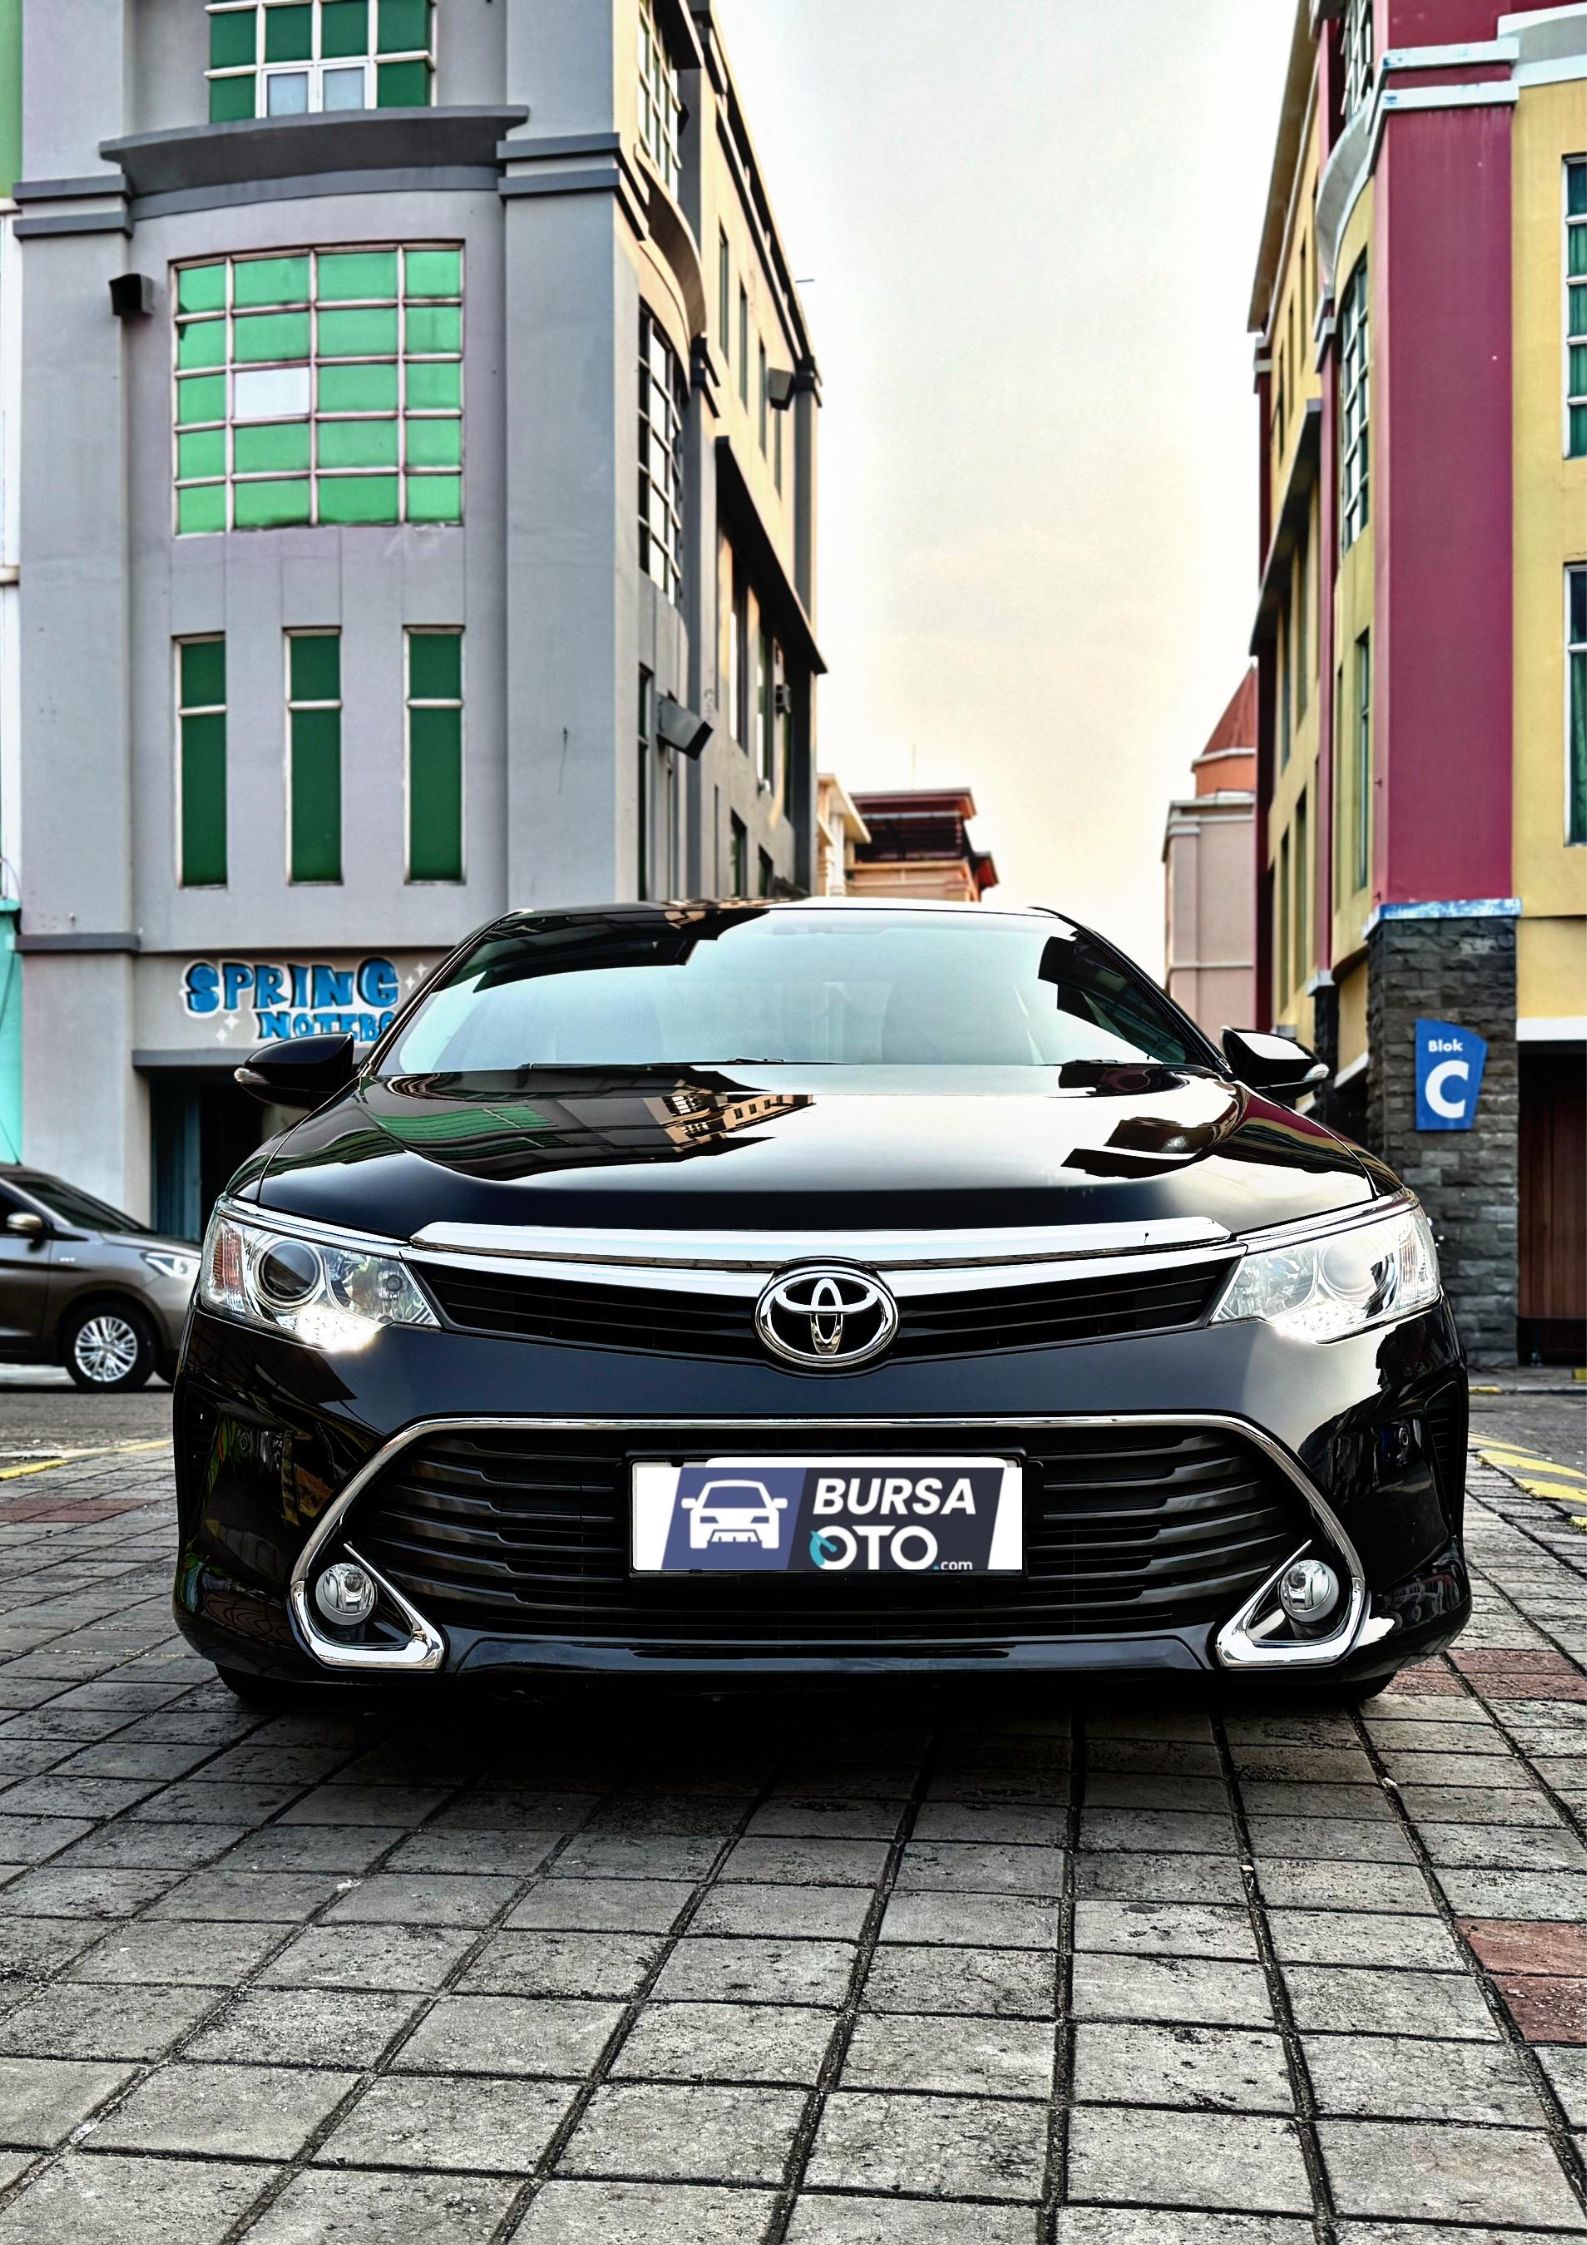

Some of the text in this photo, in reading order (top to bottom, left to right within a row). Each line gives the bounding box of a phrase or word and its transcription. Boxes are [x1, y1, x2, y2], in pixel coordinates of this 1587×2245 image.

[185, 956, 399, 1013] SPRING
[1428, 1038, 1463, 1053] Blok
[1425, 1059, 1470, 1119] C
